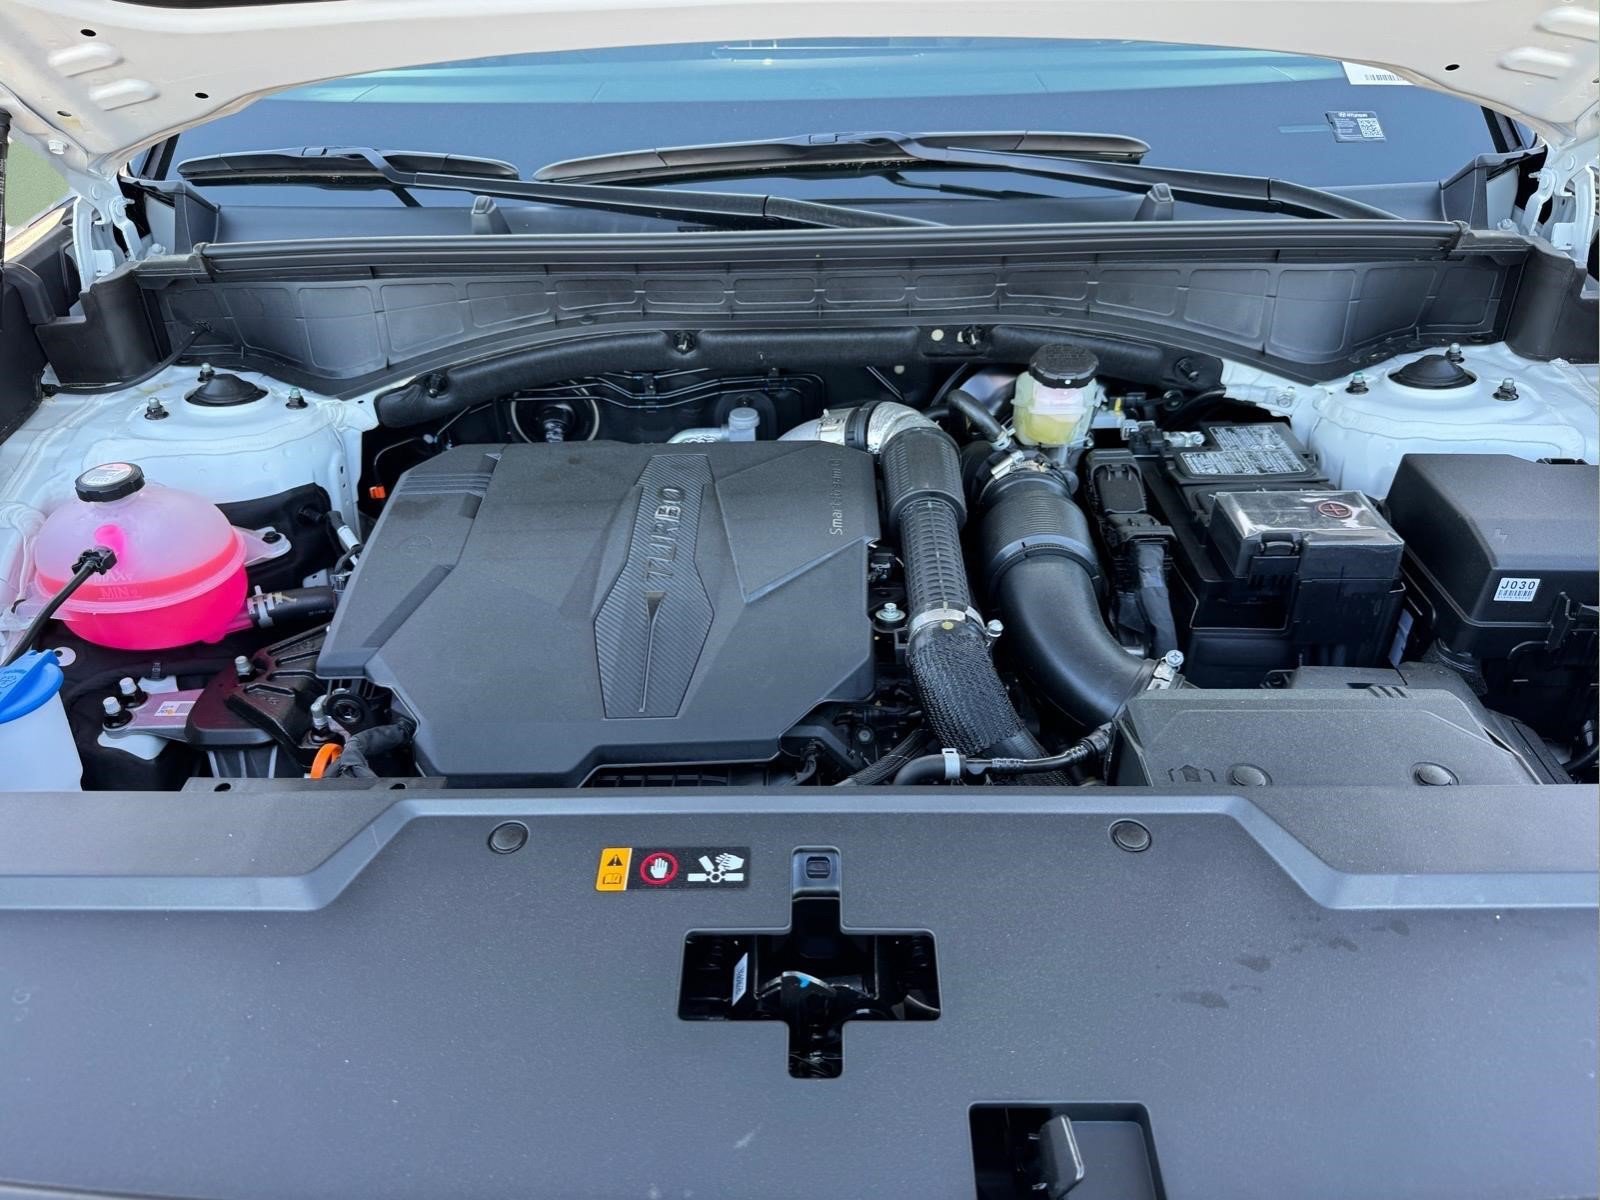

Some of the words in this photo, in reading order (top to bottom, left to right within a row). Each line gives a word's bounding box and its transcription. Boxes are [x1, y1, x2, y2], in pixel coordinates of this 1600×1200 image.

[643, 487, 685, 581] TURBO
[1501, 580, 1536, 590] J030
[100, 586, 130, 600] MIN
